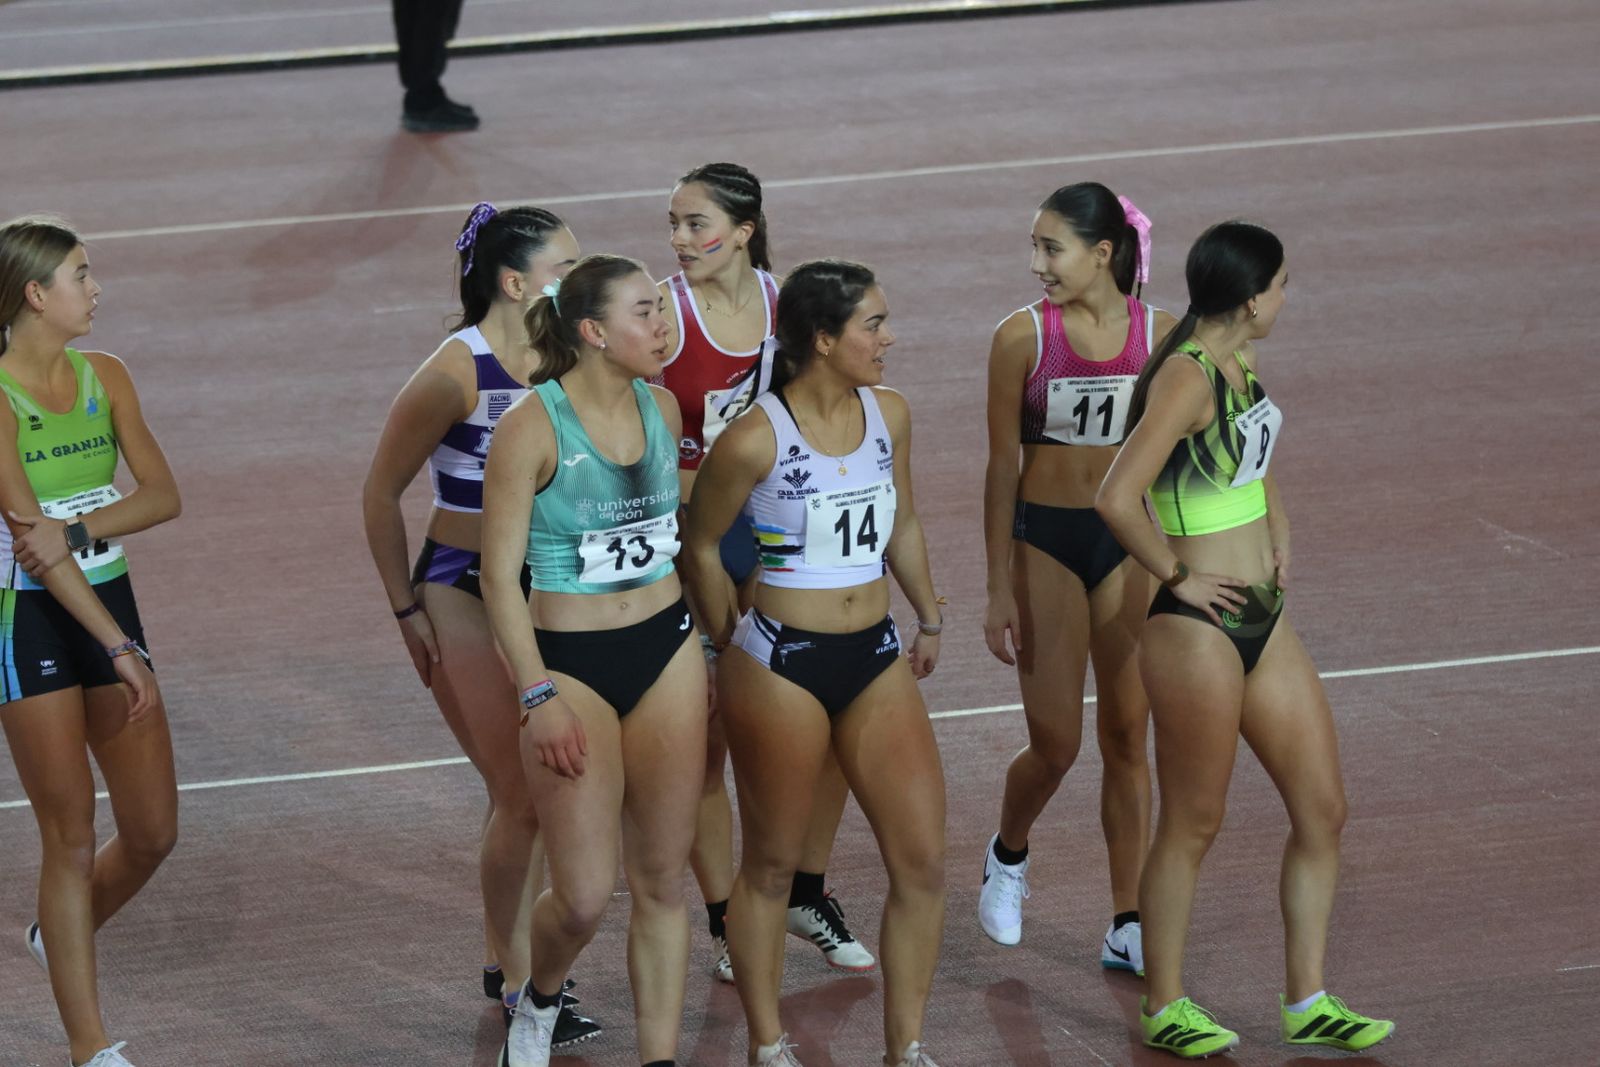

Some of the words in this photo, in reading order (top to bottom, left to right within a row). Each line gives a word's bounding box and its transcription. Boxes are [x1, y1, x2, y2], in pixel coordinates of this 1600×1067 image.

[1073, 394, 1114, 437] 11
[25, 450, 47, 463] LA
[51, 435, 108, 457] GRANJA
[779, 454, 810, 466] VIATOR
[1255, 423, 1270, 470] 9
[611, 508, 643, 522] león
[834, 503, 878, 557] 14
[606, 535, 655, 571] 13
